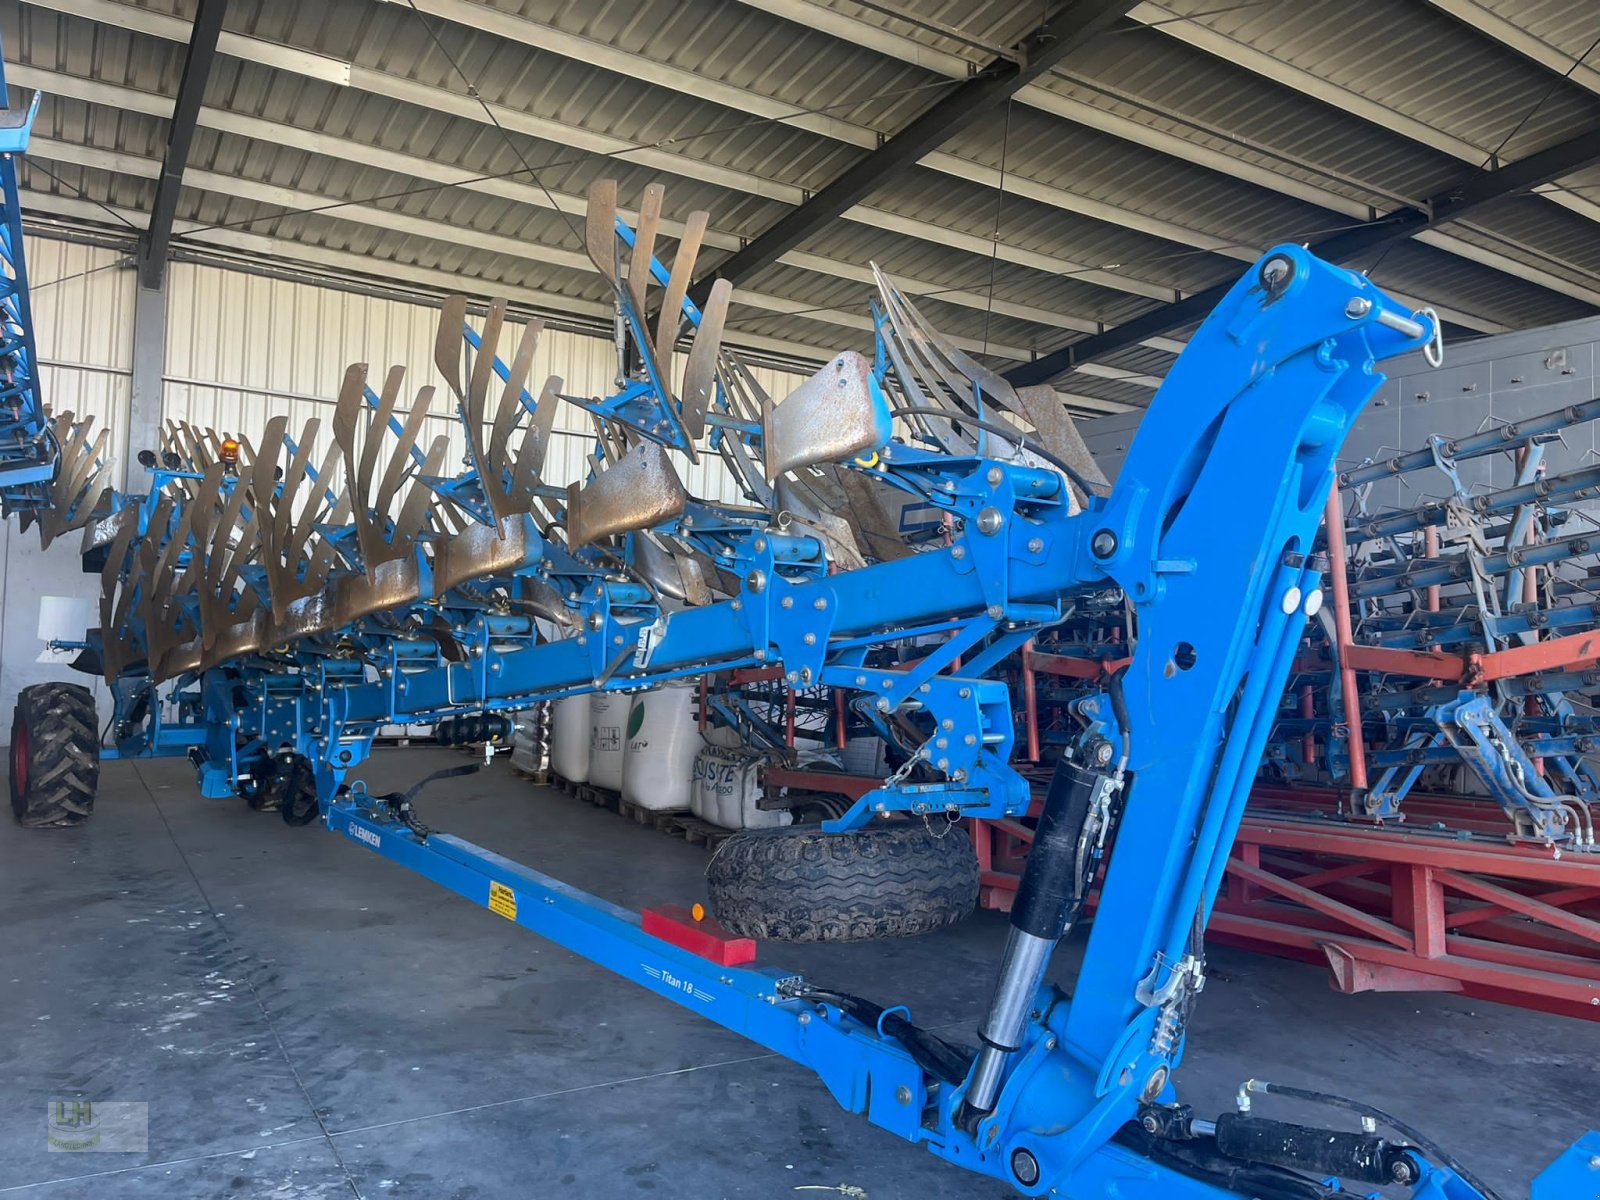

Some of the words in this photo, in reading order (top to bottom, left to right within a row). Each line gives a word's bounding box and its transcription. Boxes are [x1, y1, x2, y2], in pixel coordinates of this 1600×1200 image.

[355, 825, 381, 848] LEMKEN
[662, 970, 681, 989] Titan
[683, 981, 693, 994] 18
